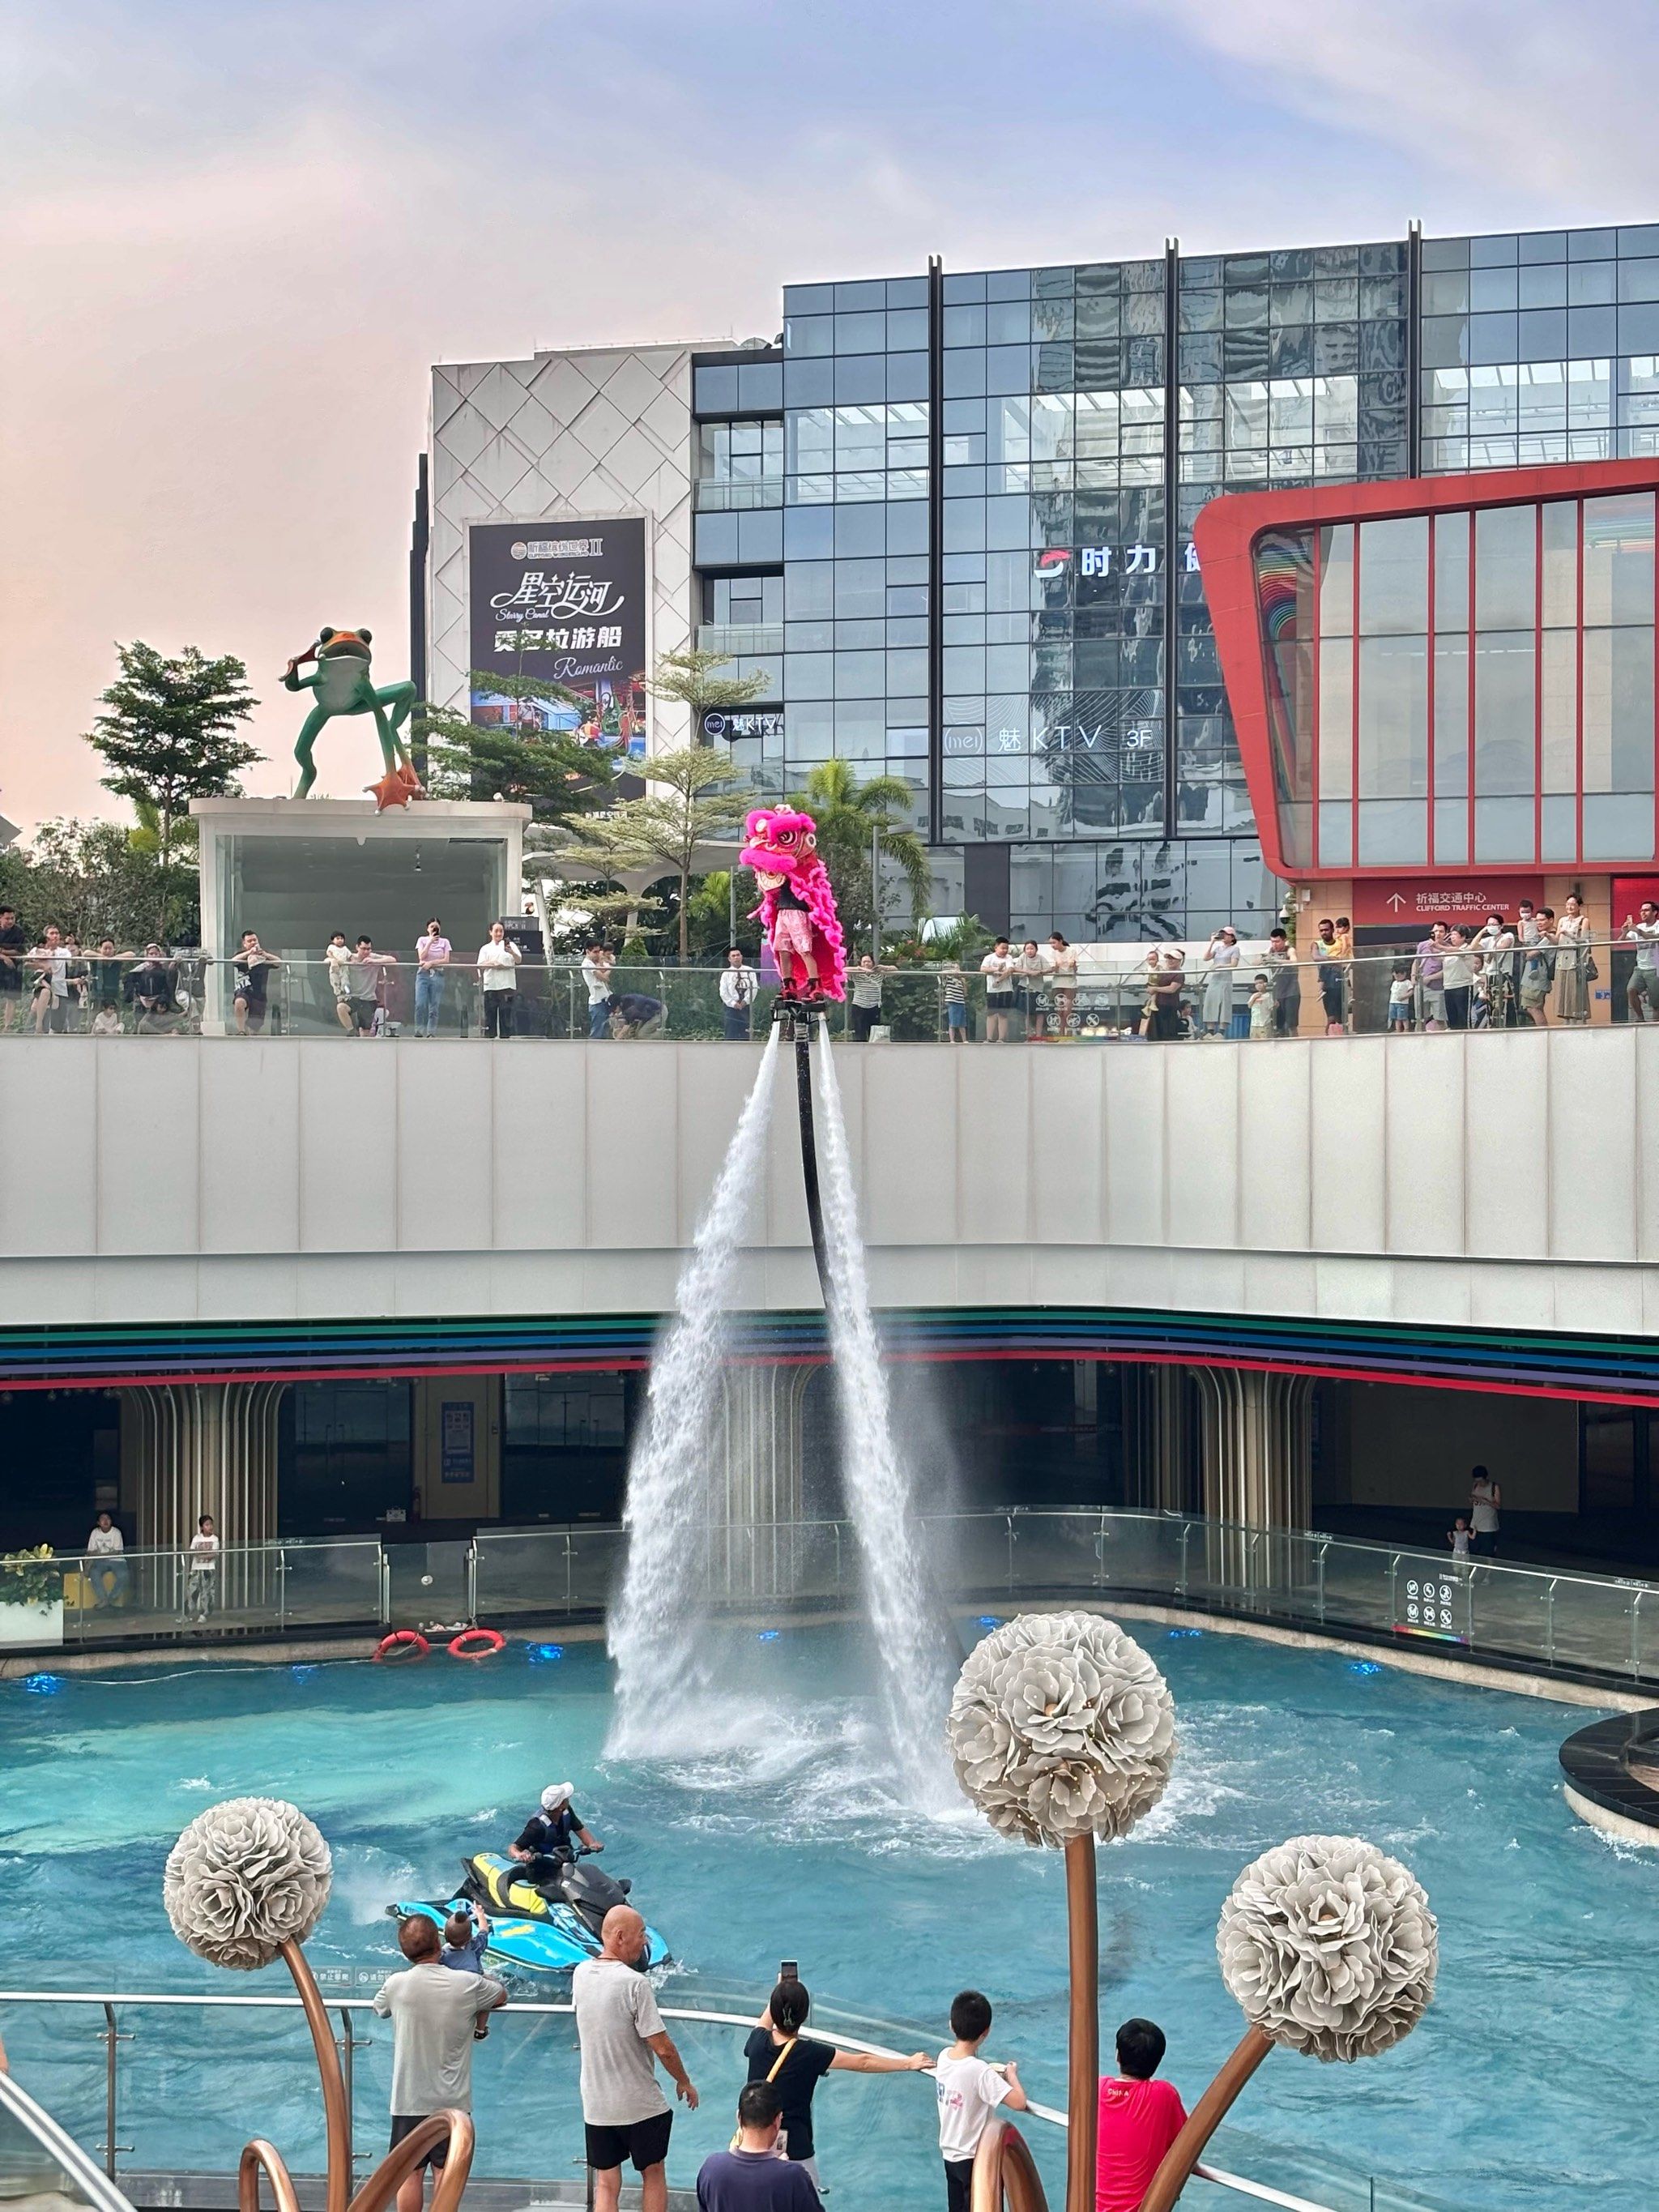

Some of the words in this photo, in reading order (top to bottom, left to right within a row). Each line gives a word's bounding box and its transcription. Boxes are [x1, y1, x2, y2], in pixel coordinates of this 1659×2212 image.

[490, 571, 625, 619] 星空运河
[496, 609, 523, 622] Starry
[525, 609, 548, 621] Canal
[554, 655, 623, 679] Romantic
[1126, 729, 1152, 748] 3F
[1416, 892, 1486, 904] 祈福交通中心
